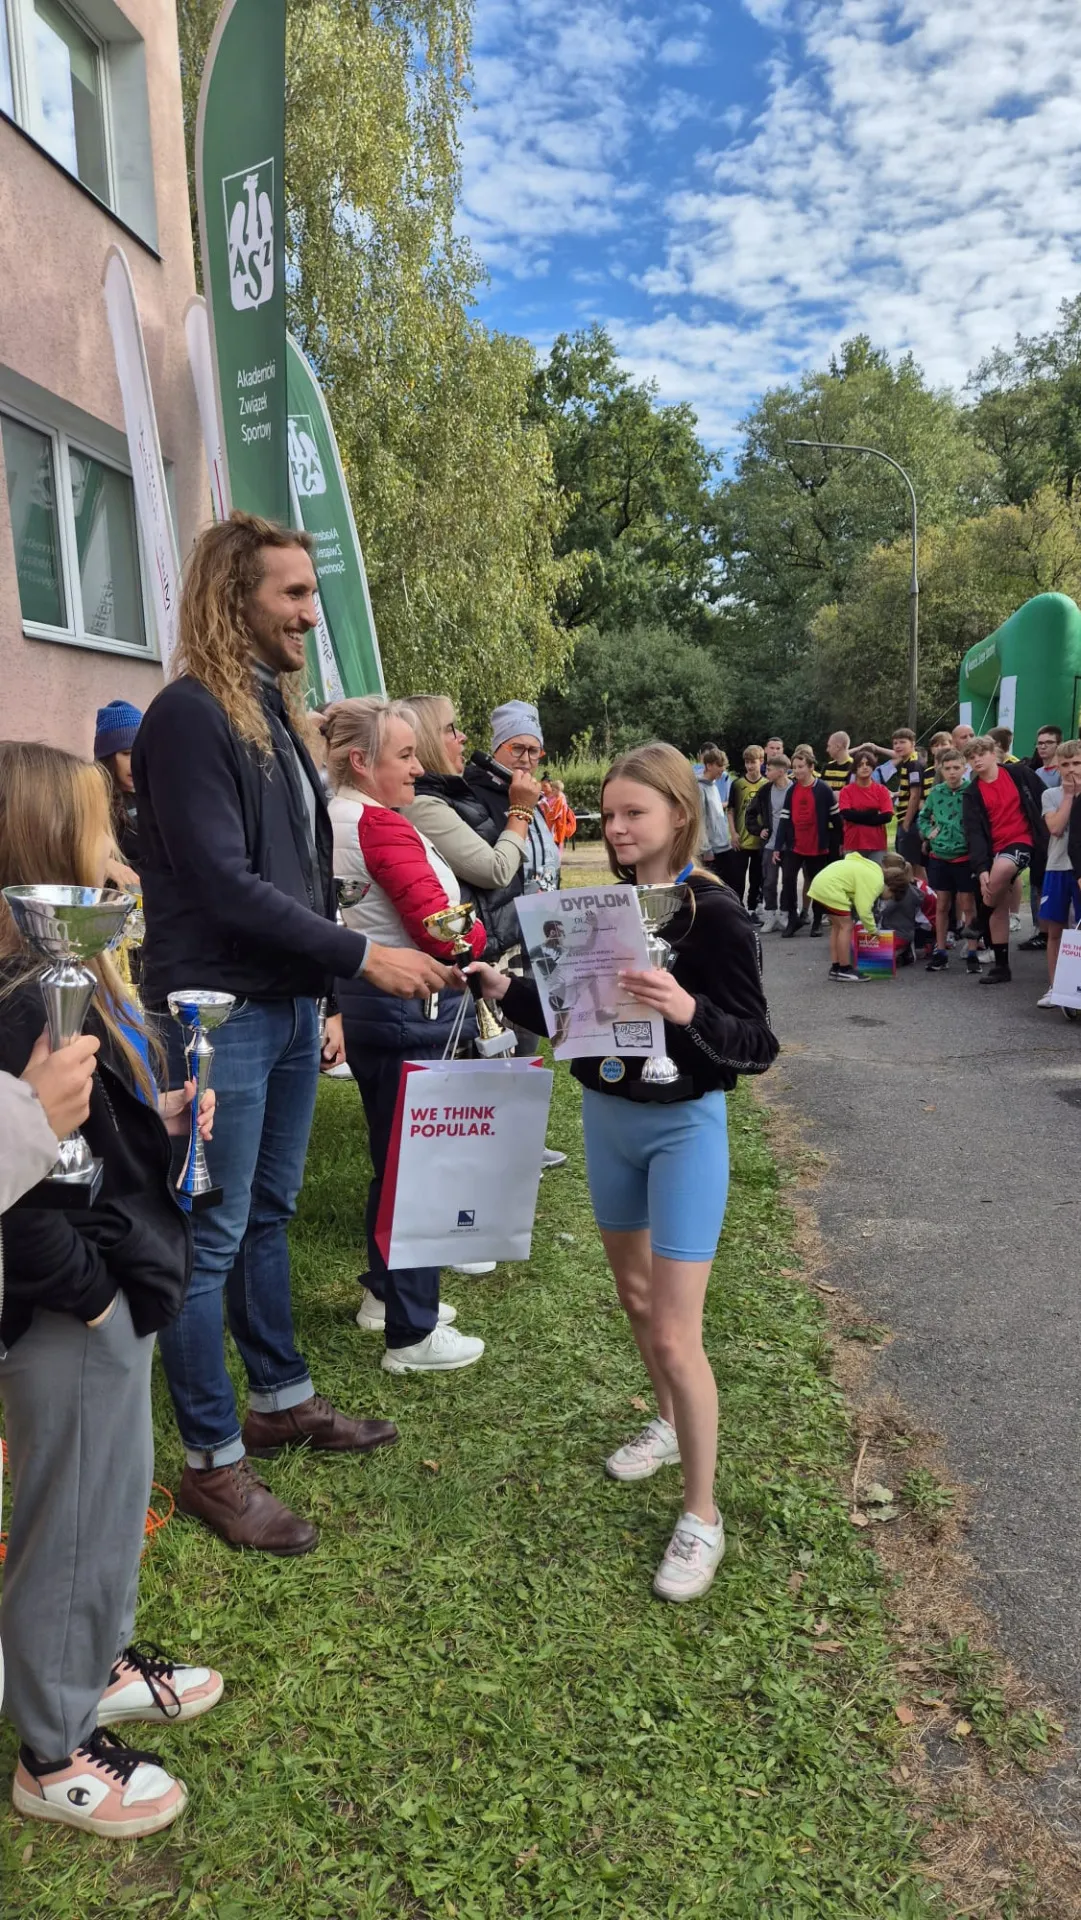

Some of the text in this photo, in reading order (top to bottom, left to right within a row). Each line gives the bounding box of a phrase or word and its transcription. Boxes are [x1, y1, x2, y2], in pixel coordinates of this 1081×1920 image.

[237, 359, 275, 388] Akademicki
[238, 391, 268, 416] Związek
[241, 421, 272, 446] Sportowy
[561, 893, 631, 912] DYPLOM
[410, 1106, 496, 1121] WE THINK
[410, 1123, 496, 1138] POPULAR.
